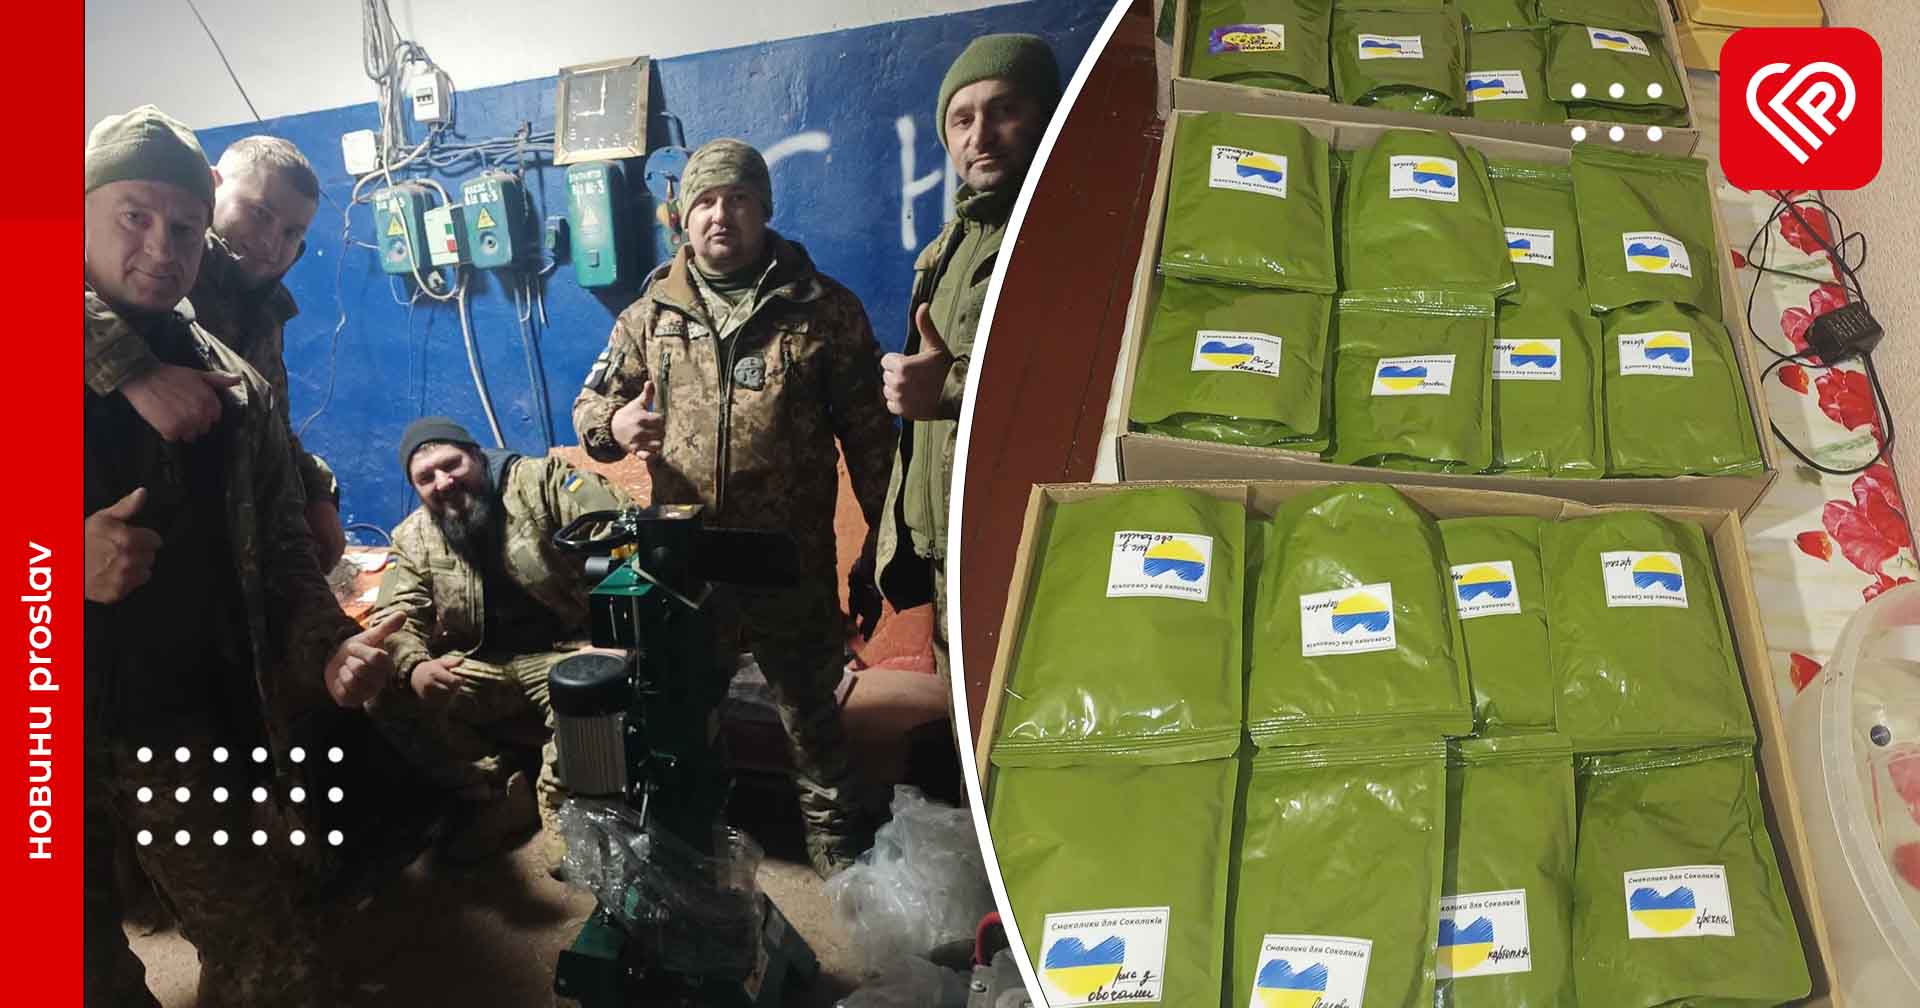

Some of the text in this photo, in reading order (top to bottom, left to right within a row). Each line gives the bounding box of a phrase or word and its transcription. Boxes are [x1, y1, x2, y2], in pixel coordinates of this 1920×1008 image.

[1440, 903, 1468, 912] колики
[1051, 915, 1162, 931] Смаколики для Соколиків
[1265, 943, 1308, 953] Смаколики
[1308, 944, 1323, 954] для
